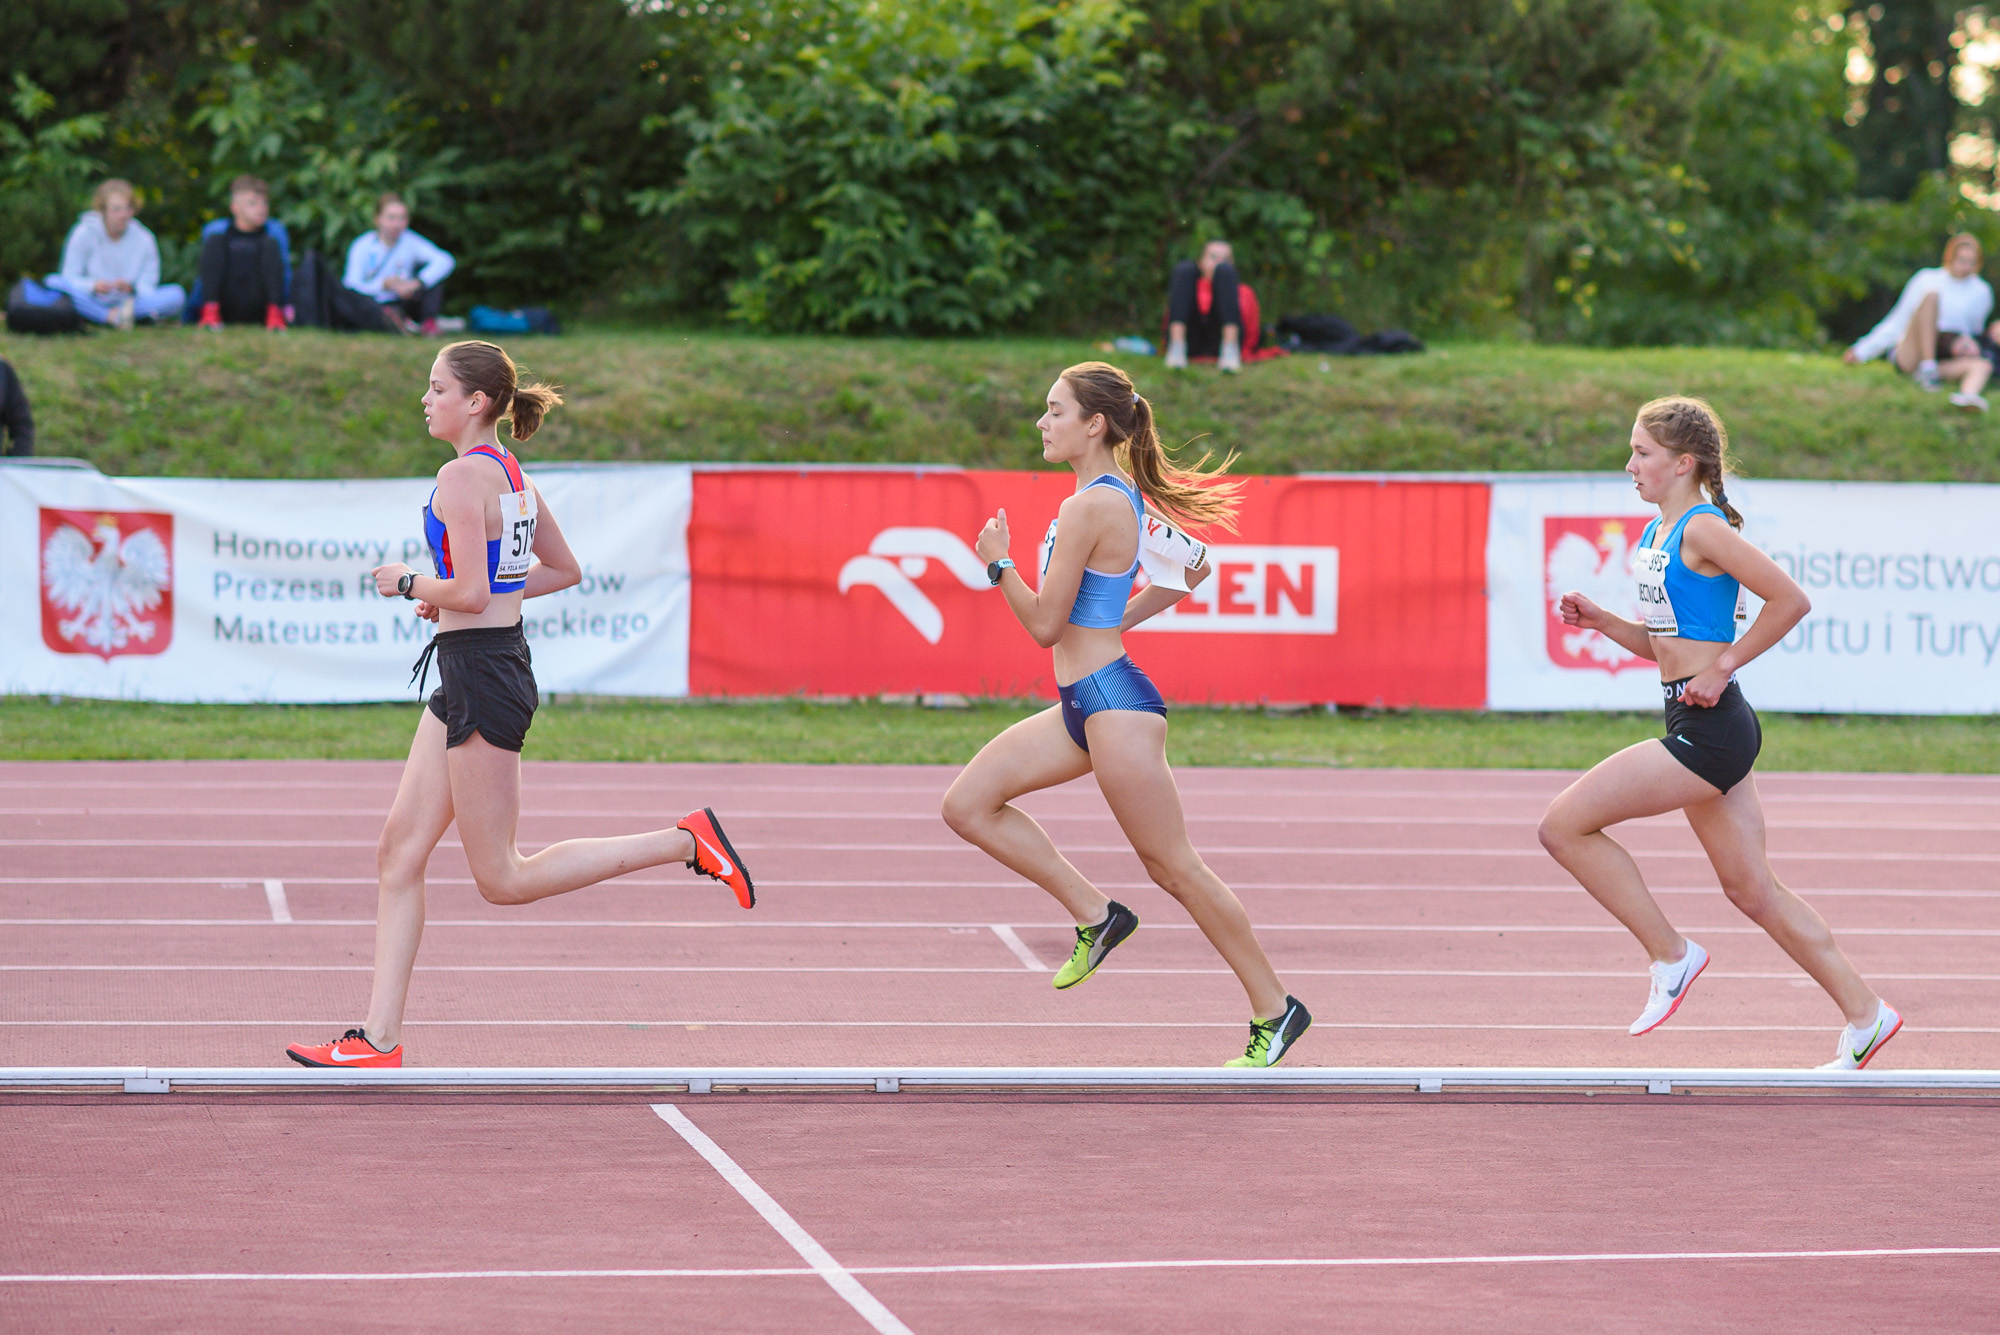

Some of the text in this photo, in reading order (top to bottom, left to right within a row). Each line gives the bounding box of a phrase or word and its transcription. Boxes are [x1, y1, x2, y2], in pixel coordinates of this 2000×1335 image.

[213, 530, 390, 567] Honorowy
[1761, 543, 2000, 592] nisterstwo
[214, 571, 345, 602] Prezesa
[214, 614, 378, 645] Mateusza
[1885, 611, 1893, 657] i
